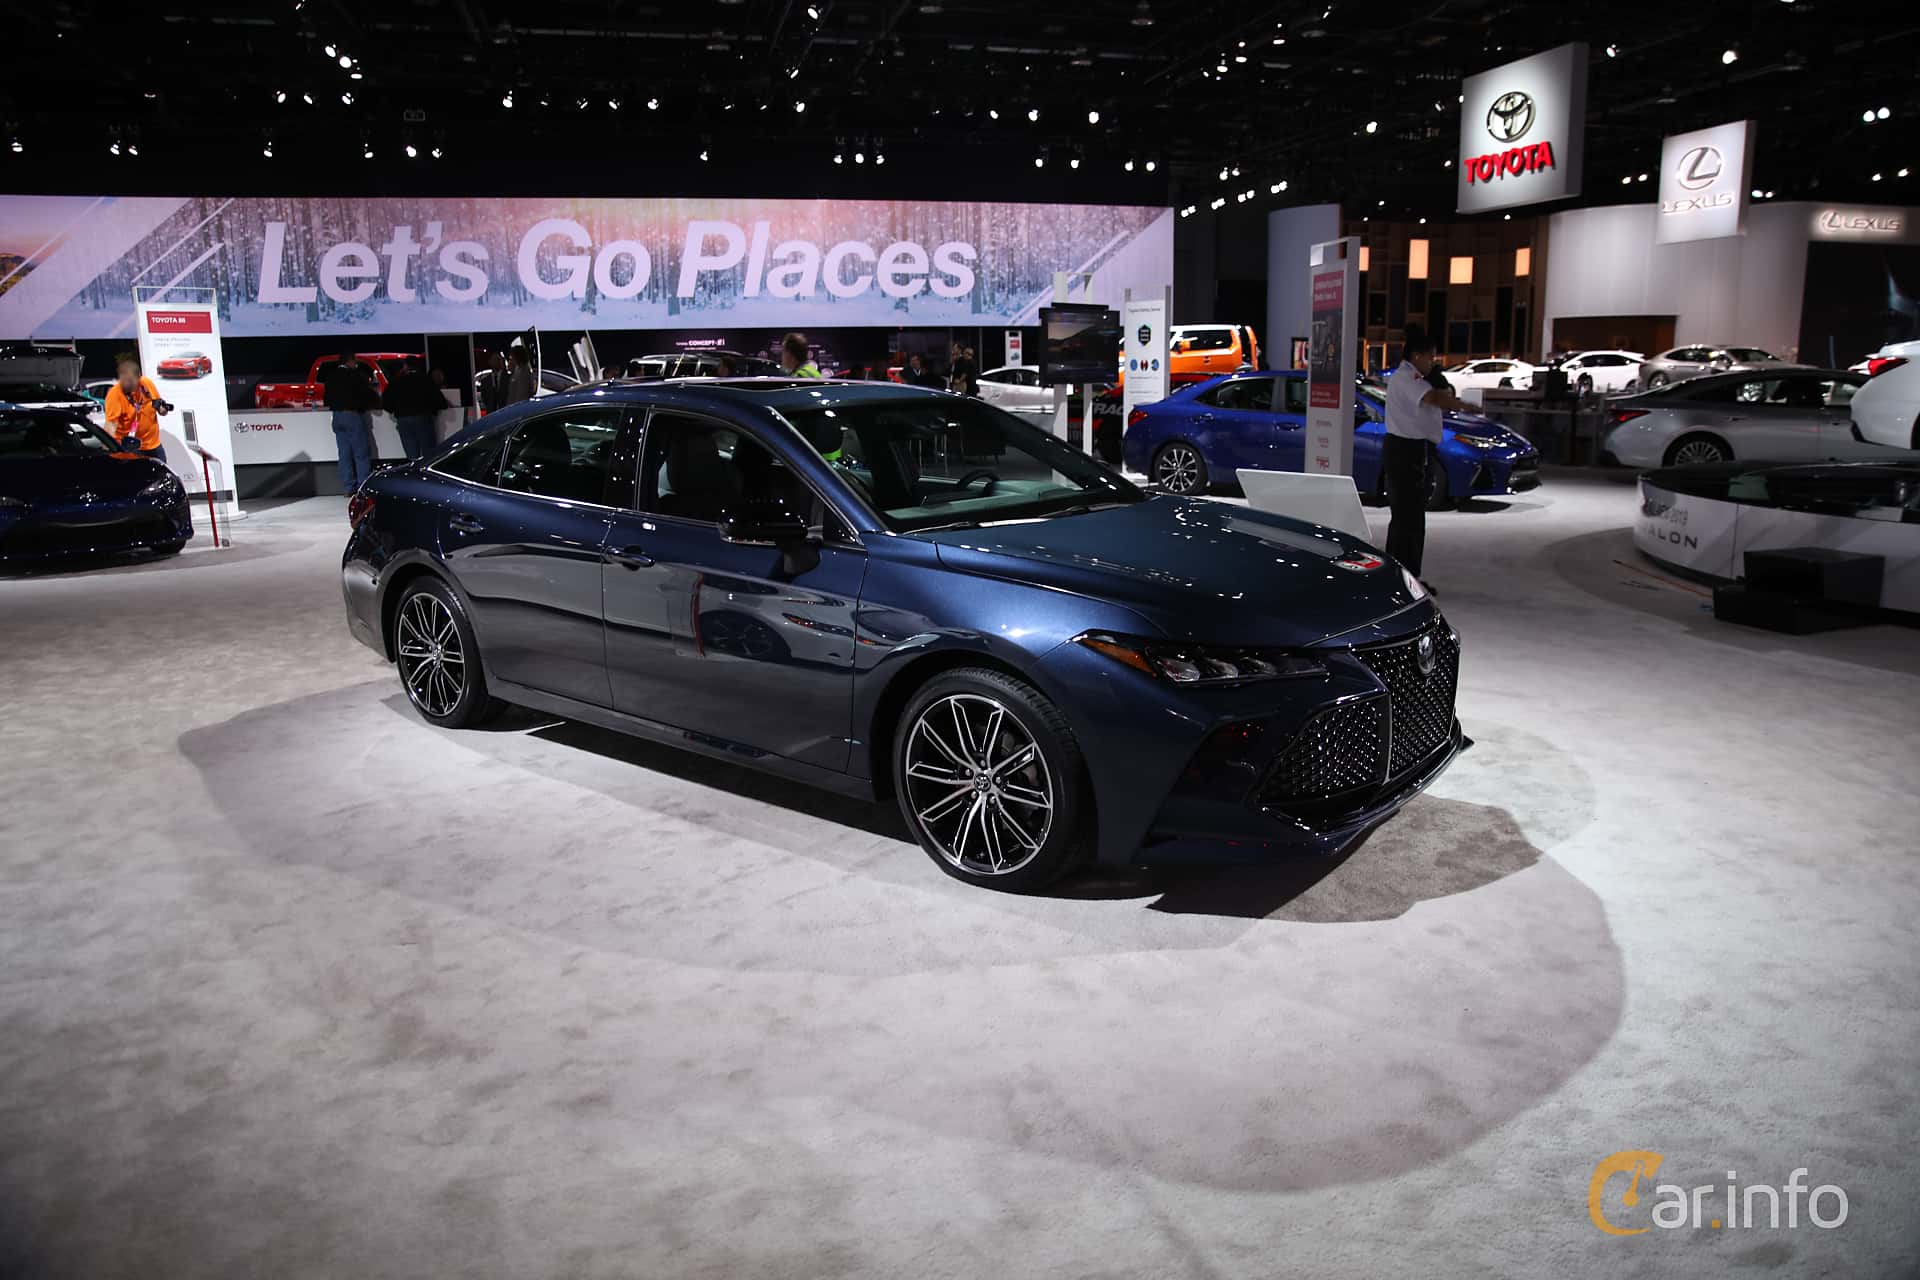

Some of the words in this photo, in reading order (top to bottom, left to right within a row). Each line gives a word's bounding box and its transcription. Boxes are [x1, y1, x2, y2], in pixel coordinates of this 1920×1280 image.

[1464, 141, 1555, 184] TOYOTA
[1662, 191, 1734, 214] LEXUS
[1842, 215, 1901, 232] LEXUS
[257, 221, 490, 303] Let's
[517, 218, 652, 301] Go
[676, 220, 977, 300] Places
[250, 423, 283, 431] TOYOTA
